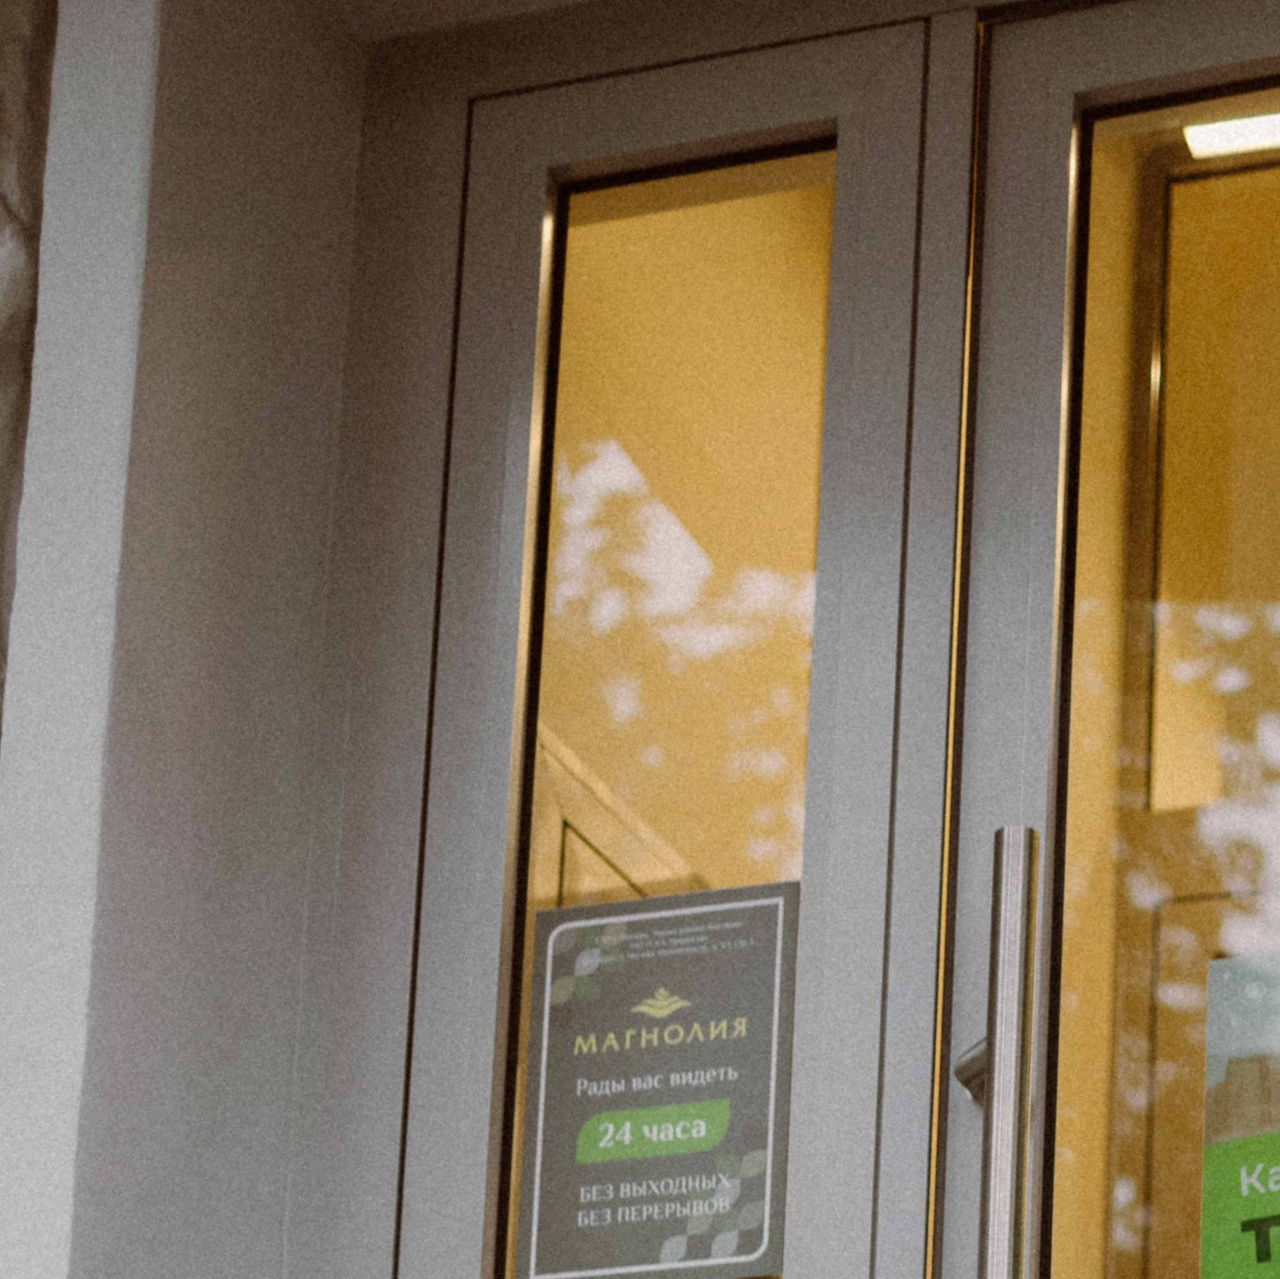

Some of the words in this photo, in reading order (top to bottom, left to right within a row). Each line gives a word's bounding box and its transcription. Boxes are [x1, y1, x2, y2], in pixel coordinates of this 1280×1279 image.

[574, 1017, 748, 1055] МАГНОЛИЯ
[576, 1076, 625, 1097] Рады
[632, 1073, 662, 1091] вас
[670, 1066, 738, 1087] видеть
[599, 1122, 632, 1147] 24
[643, 1118, 706, 1143] часа
[580, 1185, 613, 1203] БЕЗ
[620, 1173, 731, 1199] ВЫХОДНЫХ
[578, 1208, 611, 1227] БЕЗ
[617, 1200, 730, 1223] ПЕРЕРЫВОВ
